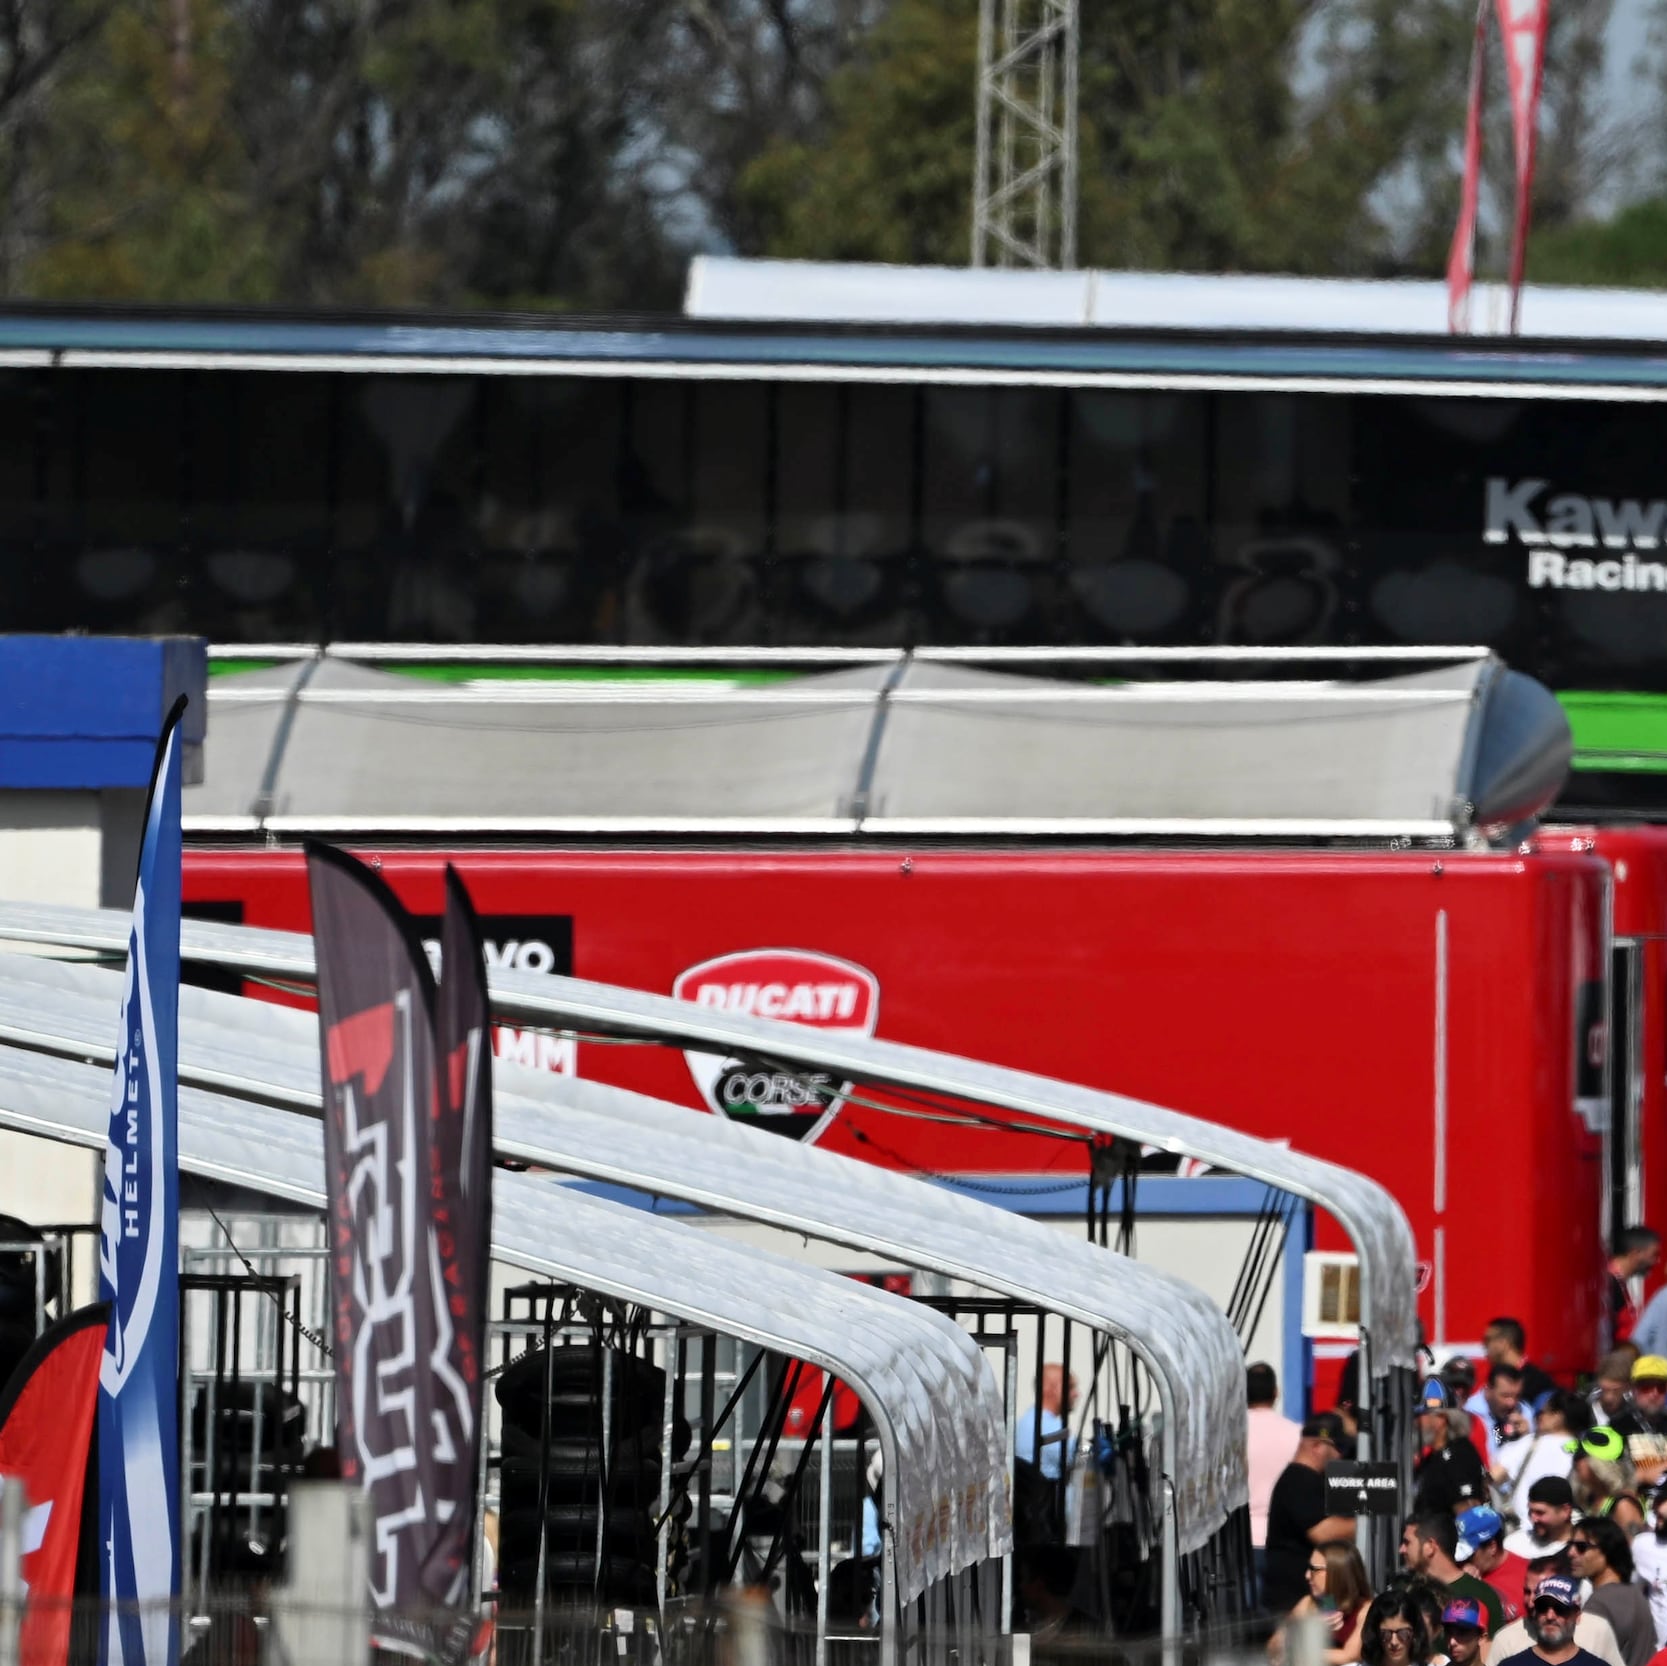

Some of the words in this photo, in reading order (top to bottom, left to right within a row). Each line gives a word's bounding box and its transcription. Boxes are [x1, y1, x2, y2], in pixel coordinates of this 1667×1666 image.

[125, 1049, 140, 1238] HELMET
[1327, 1477, 1365, 1489] WORK
[1366, 1477, 1398, 1489] AREA
[1357, 1489, 1368, 1501] A
